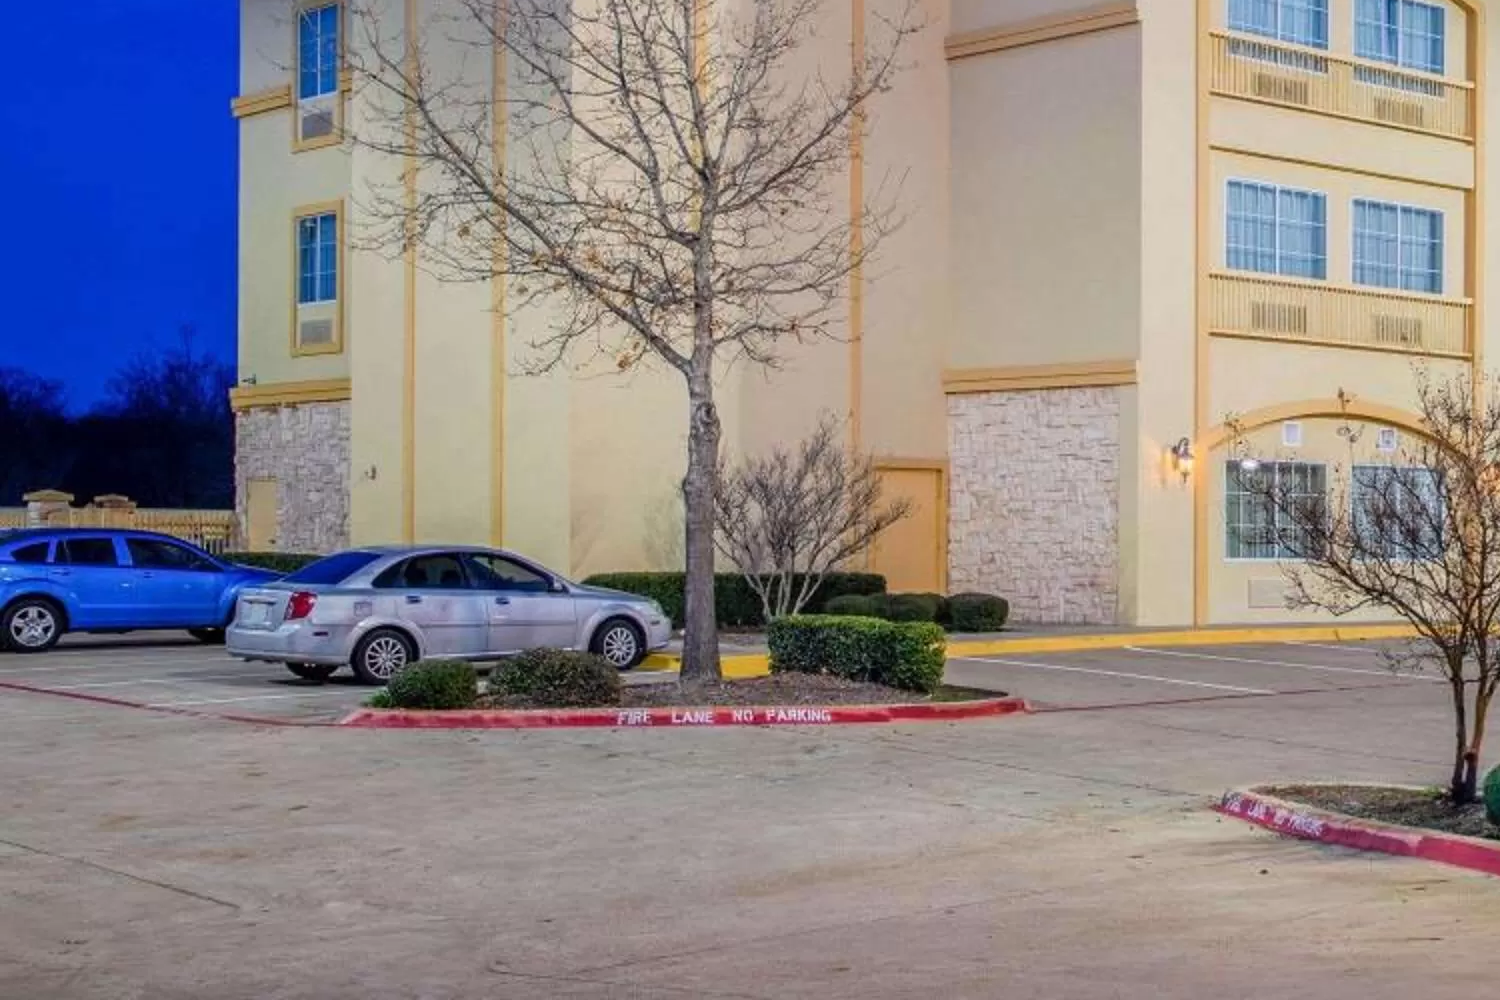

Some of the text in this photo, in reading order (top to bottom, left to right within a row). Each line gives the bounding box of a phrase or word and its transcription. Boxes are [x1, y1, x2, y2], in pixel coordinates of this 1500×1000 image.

[617, 708, 831, 725] FIRE LANE NO PARKING
